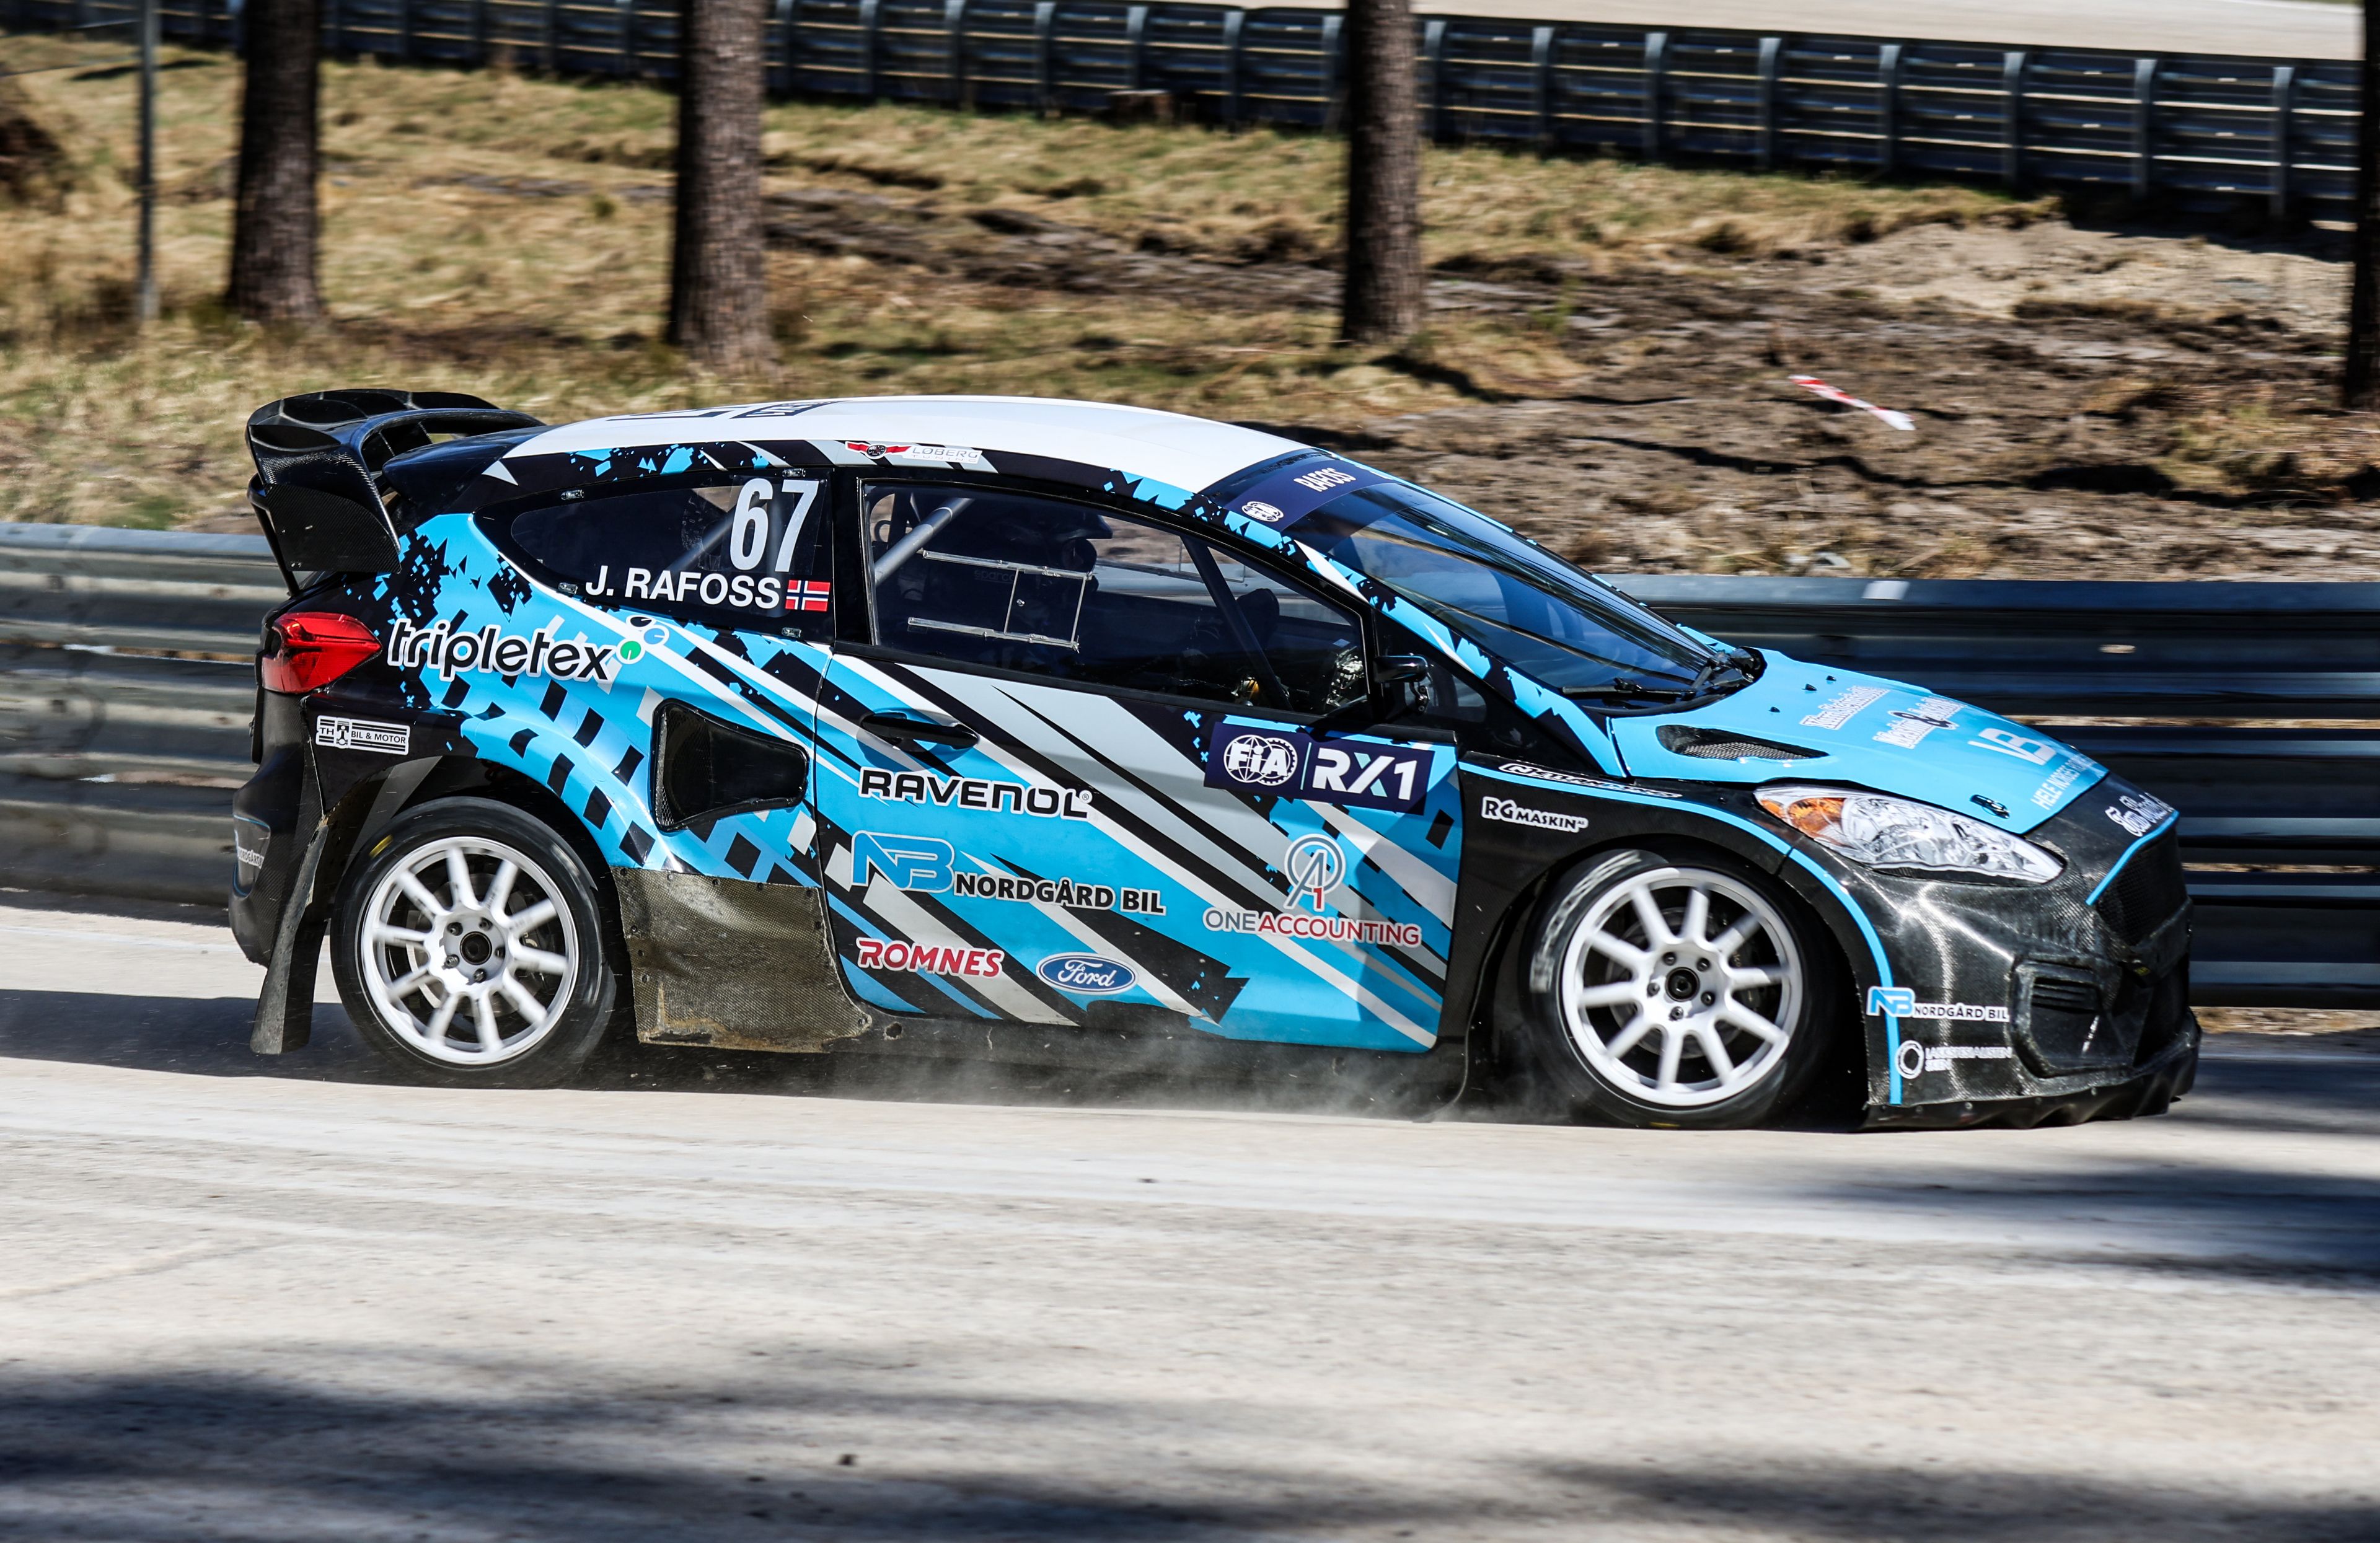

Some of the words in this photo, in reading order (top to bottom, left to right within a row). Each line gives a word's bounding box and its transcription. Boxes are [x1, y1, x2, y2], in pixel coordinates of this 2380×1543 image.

[1293, 467, 1357, 493] RAFOSS
[729, 478, 820, 573] 67
[585, 565, 614, 596] J.
[624, 567, 781, 609] RAFOSS
[390, 622, 615, 681] tripletex
[319, 727, 334, 736] TH
[351, 731, 363, 739] BIL
[374, 733, 406, 744] MOTOR
[1311, 747, 1417, 801] RX1
[2030, 782, 2063, 811] HELE
[852, 830, 954, 894] NB
[955, 874, 1114, 908] NORDGÅRD
[1122, 890, 1165, 914] BIL
[859, 940, 1003, 977] ROMNES
[1057, 959, 1116, 988] Ford
[1868, 987, 1914, 1017] NB
[1914, 1004, 1983, 1018] NORDGÅRD
[1988, 1009, 2008, 1019] BIL
